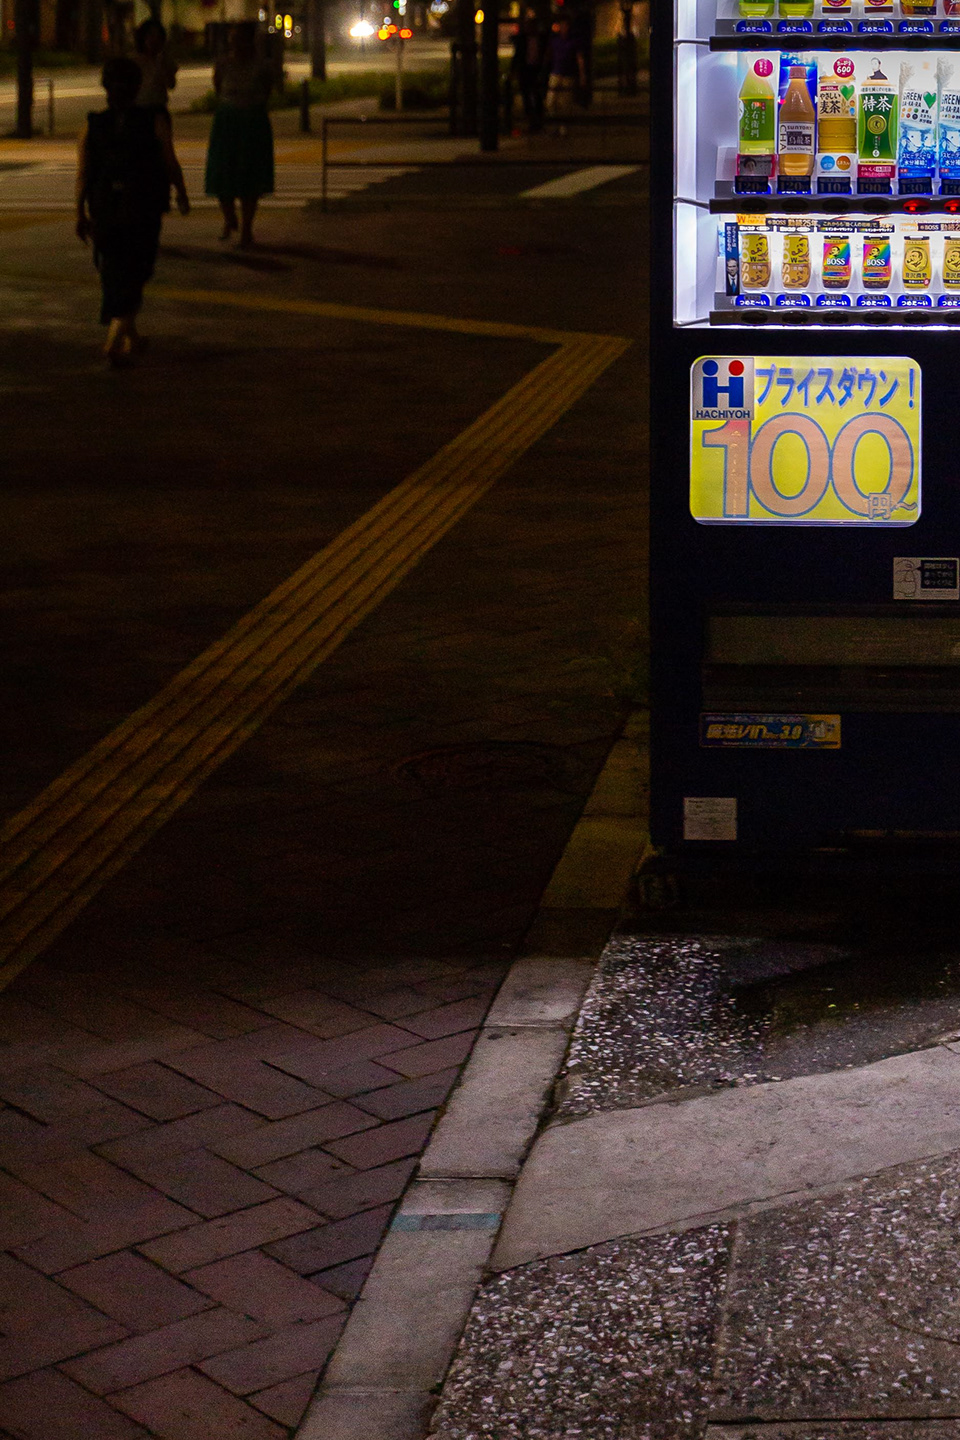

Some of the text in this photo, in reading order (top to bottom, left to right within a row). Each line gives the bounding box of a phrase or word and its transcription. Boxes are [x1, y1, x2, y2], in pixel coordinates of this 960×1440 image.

[819, 92, 841, 100] やさしい
[820, 101, 841, 114] 麦茶
[862, 95, 892, 112] 特茶
[866, 258, 886, 266] BOSS
[755, 363, 915, 409] プライスダウン!
[696, 410, 750, 418] HACHIYOH
